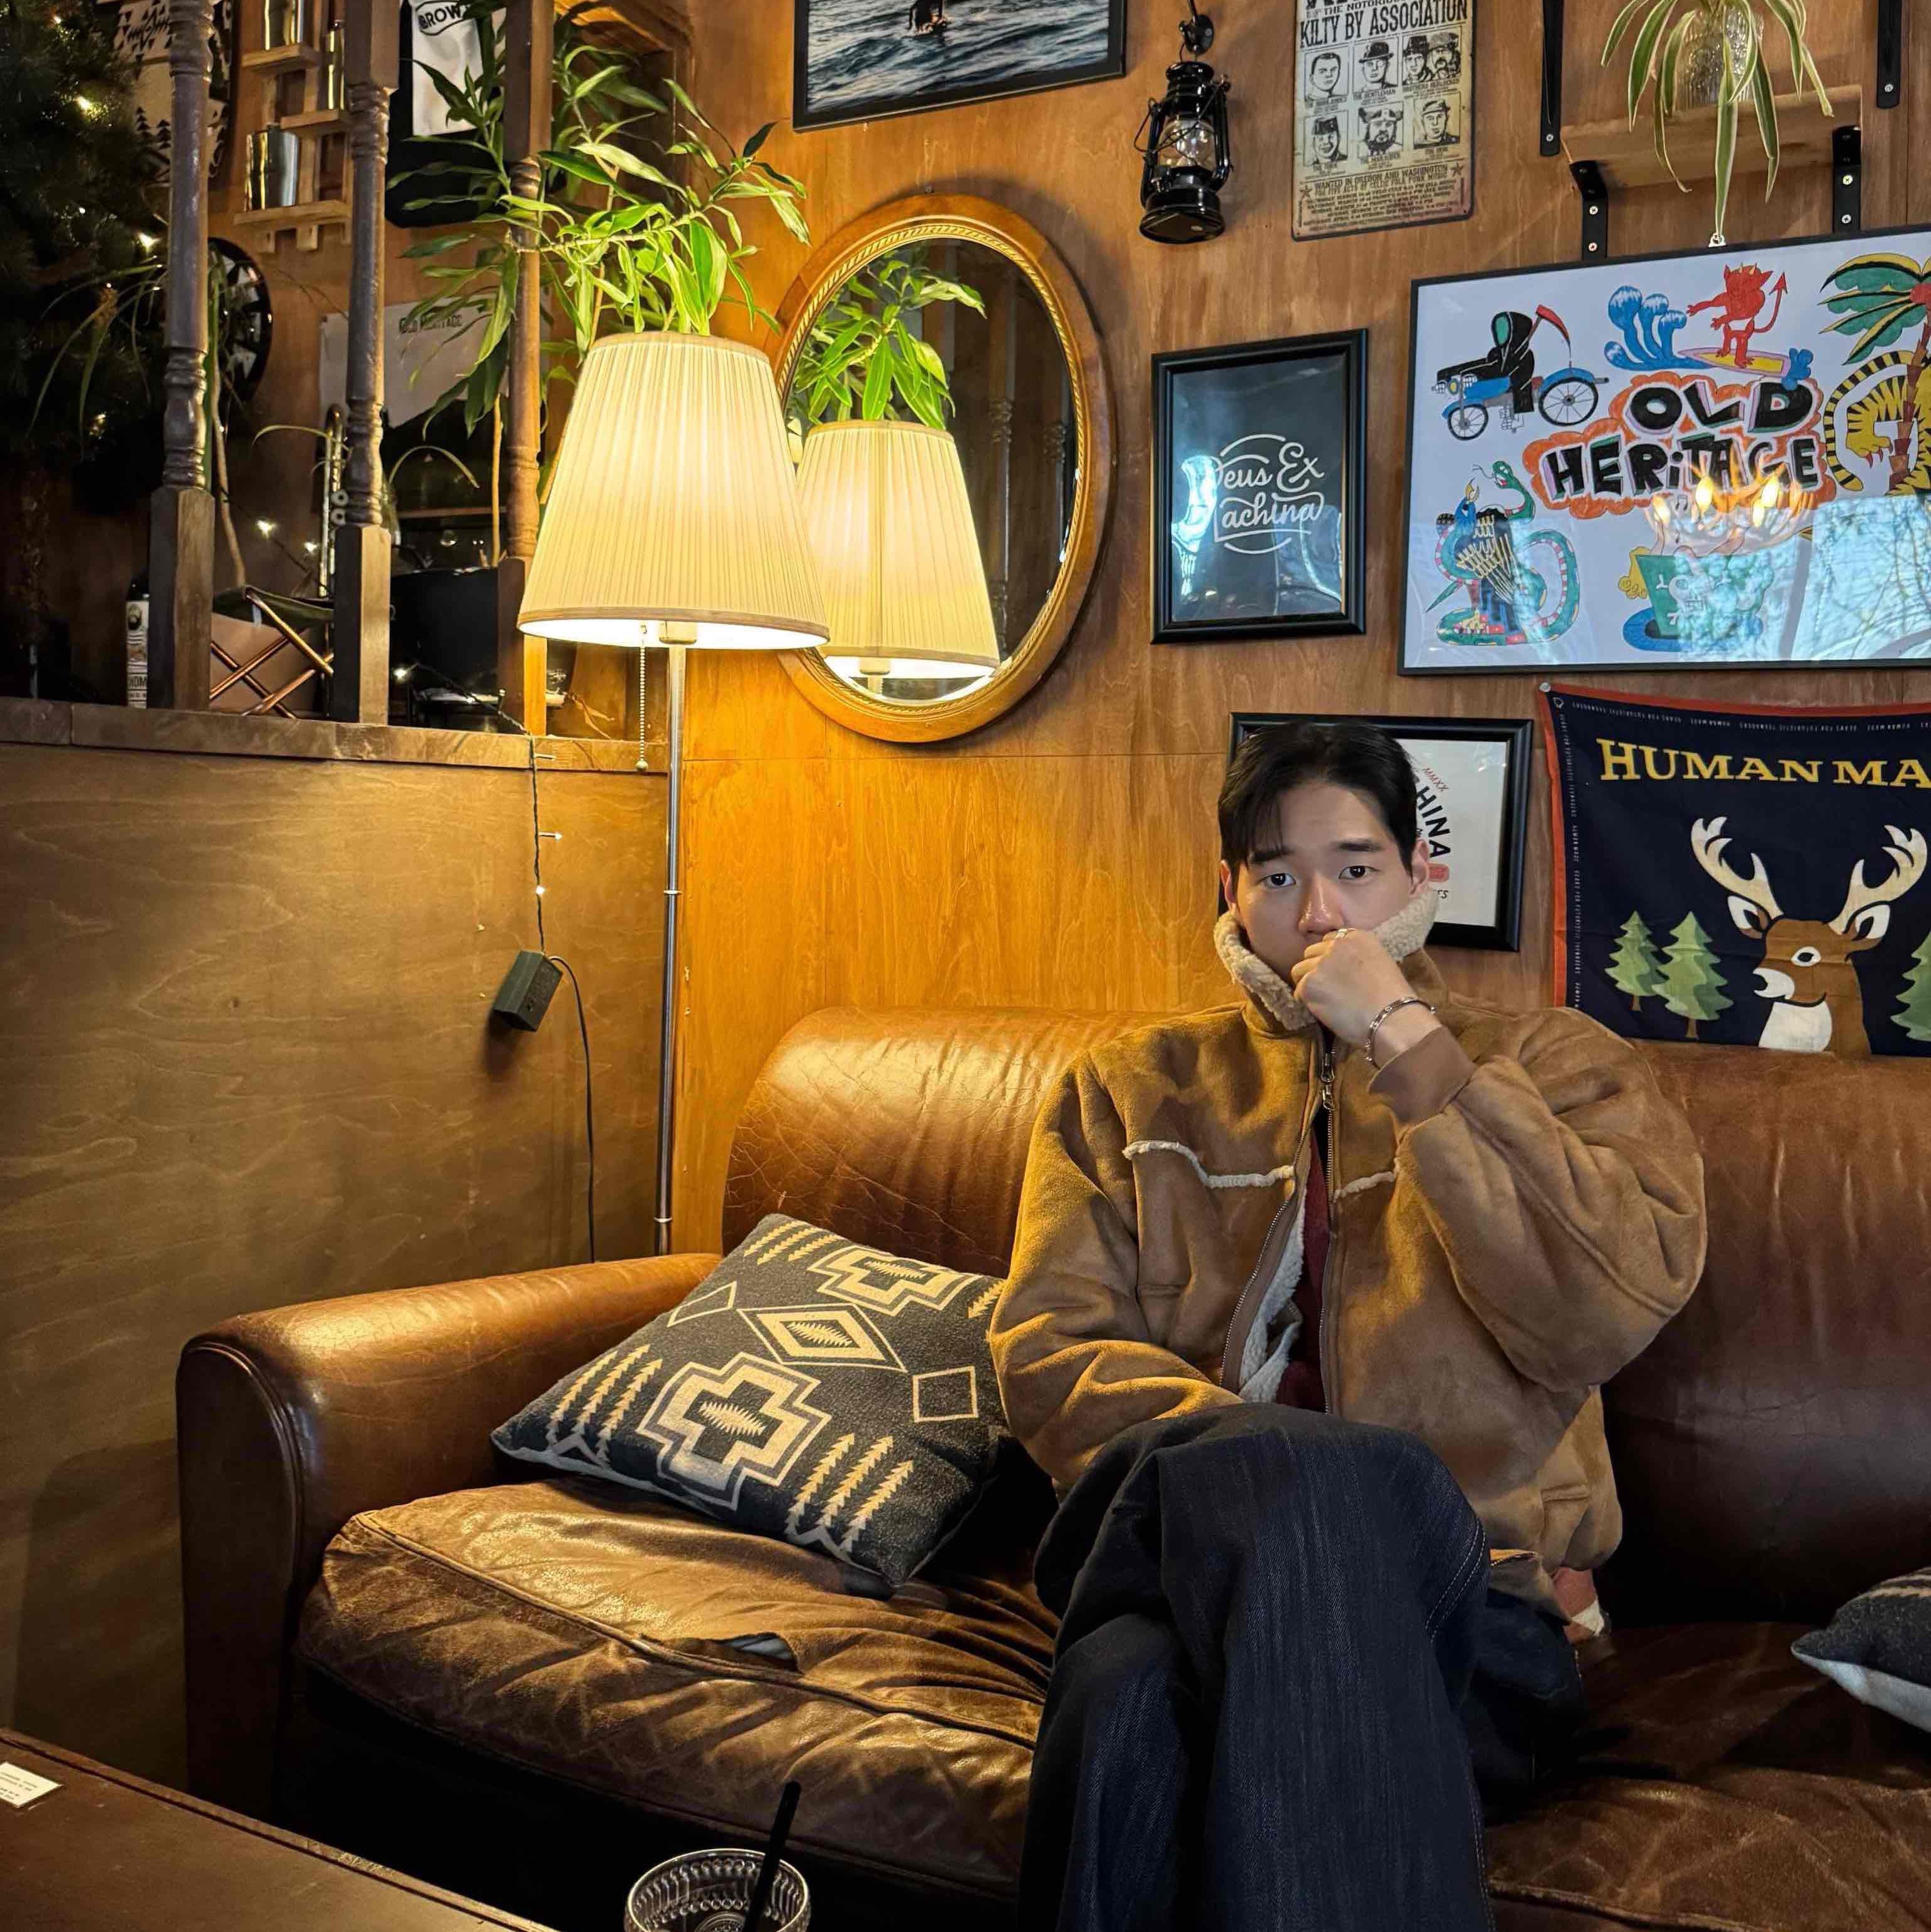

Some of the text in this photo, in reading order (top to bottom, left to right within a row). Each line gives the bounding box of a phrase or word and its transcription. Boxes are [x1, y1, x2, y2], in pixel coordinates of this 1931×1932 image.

[418, 4, 463, 29] BROW
[1300, 0, 1468, 48] KILTY BY ASSOCIATION
[1323, 6, 1342, 16] THE
[1629, 382, 1814, 434] OLD
[1276, 442, 1325, 492] Ex
[1220, 492, 1324, 529] achina
[1596, 738, 1931, 789] HUMAN MA
[1417, 786, 1451, 858] HINA
